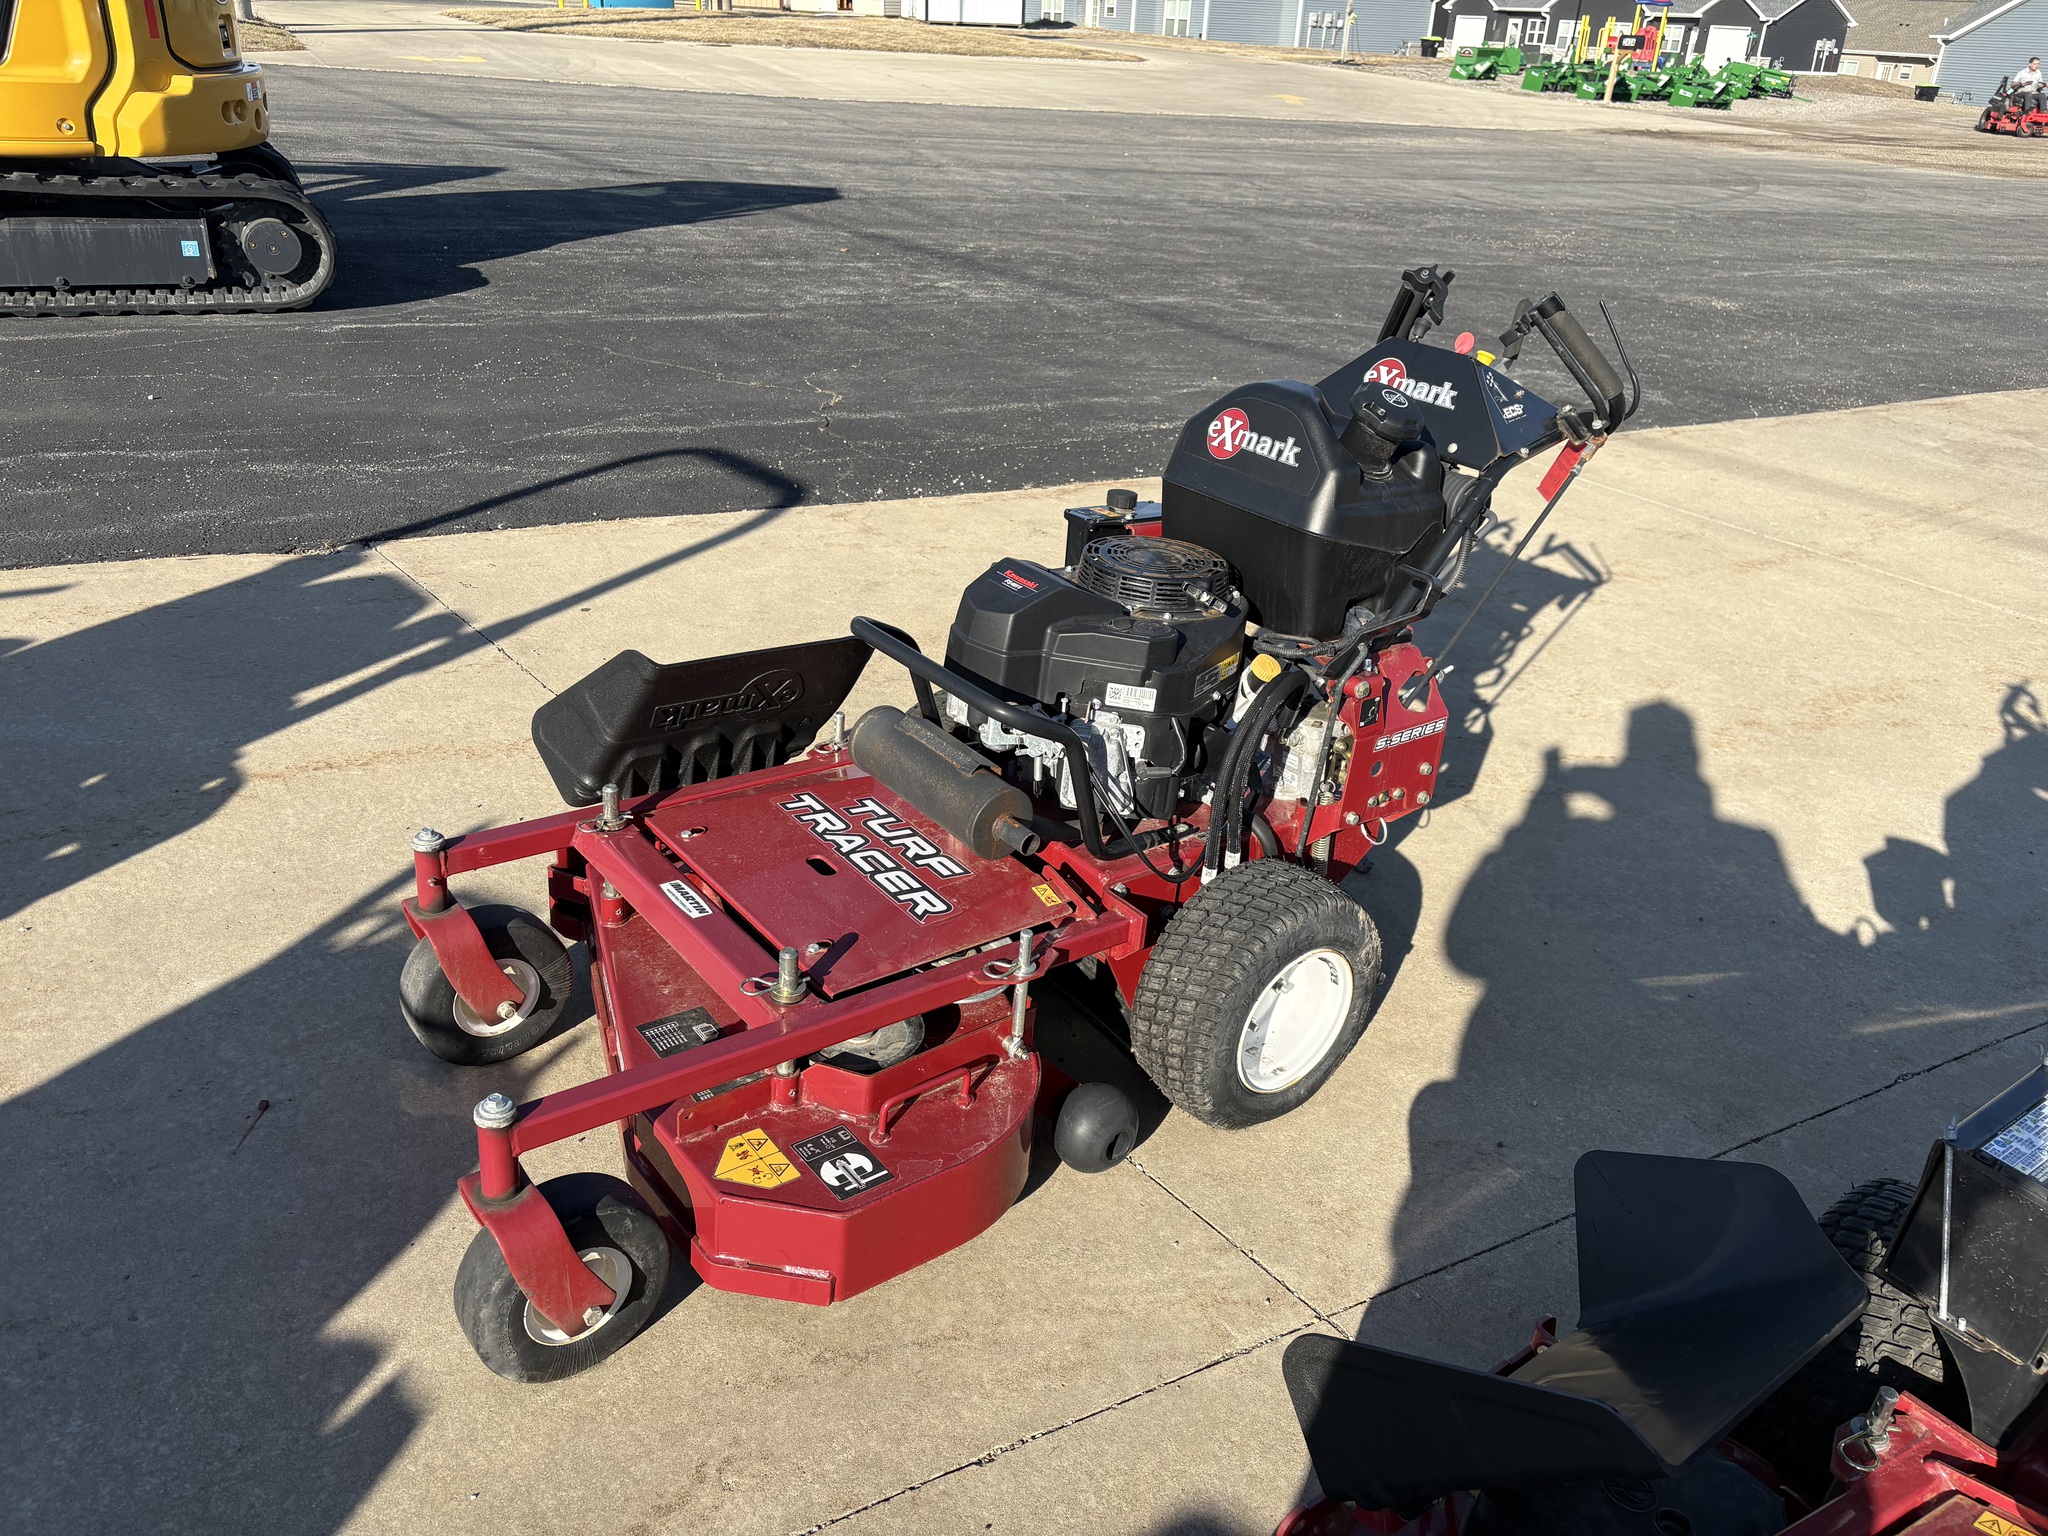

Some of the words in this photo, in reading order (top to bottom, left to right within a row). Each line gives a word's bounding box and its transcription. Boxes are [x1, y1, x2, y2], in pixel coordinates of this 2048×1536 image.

[1208, 415, 1301, 467] eXmark
[1004, 569, 1039, 589] Kawasaki
[780, 793, 951, 920] TRACER
[844, 798, 970, 878] TURF
[669, 882, 710, 914] MARTIN
